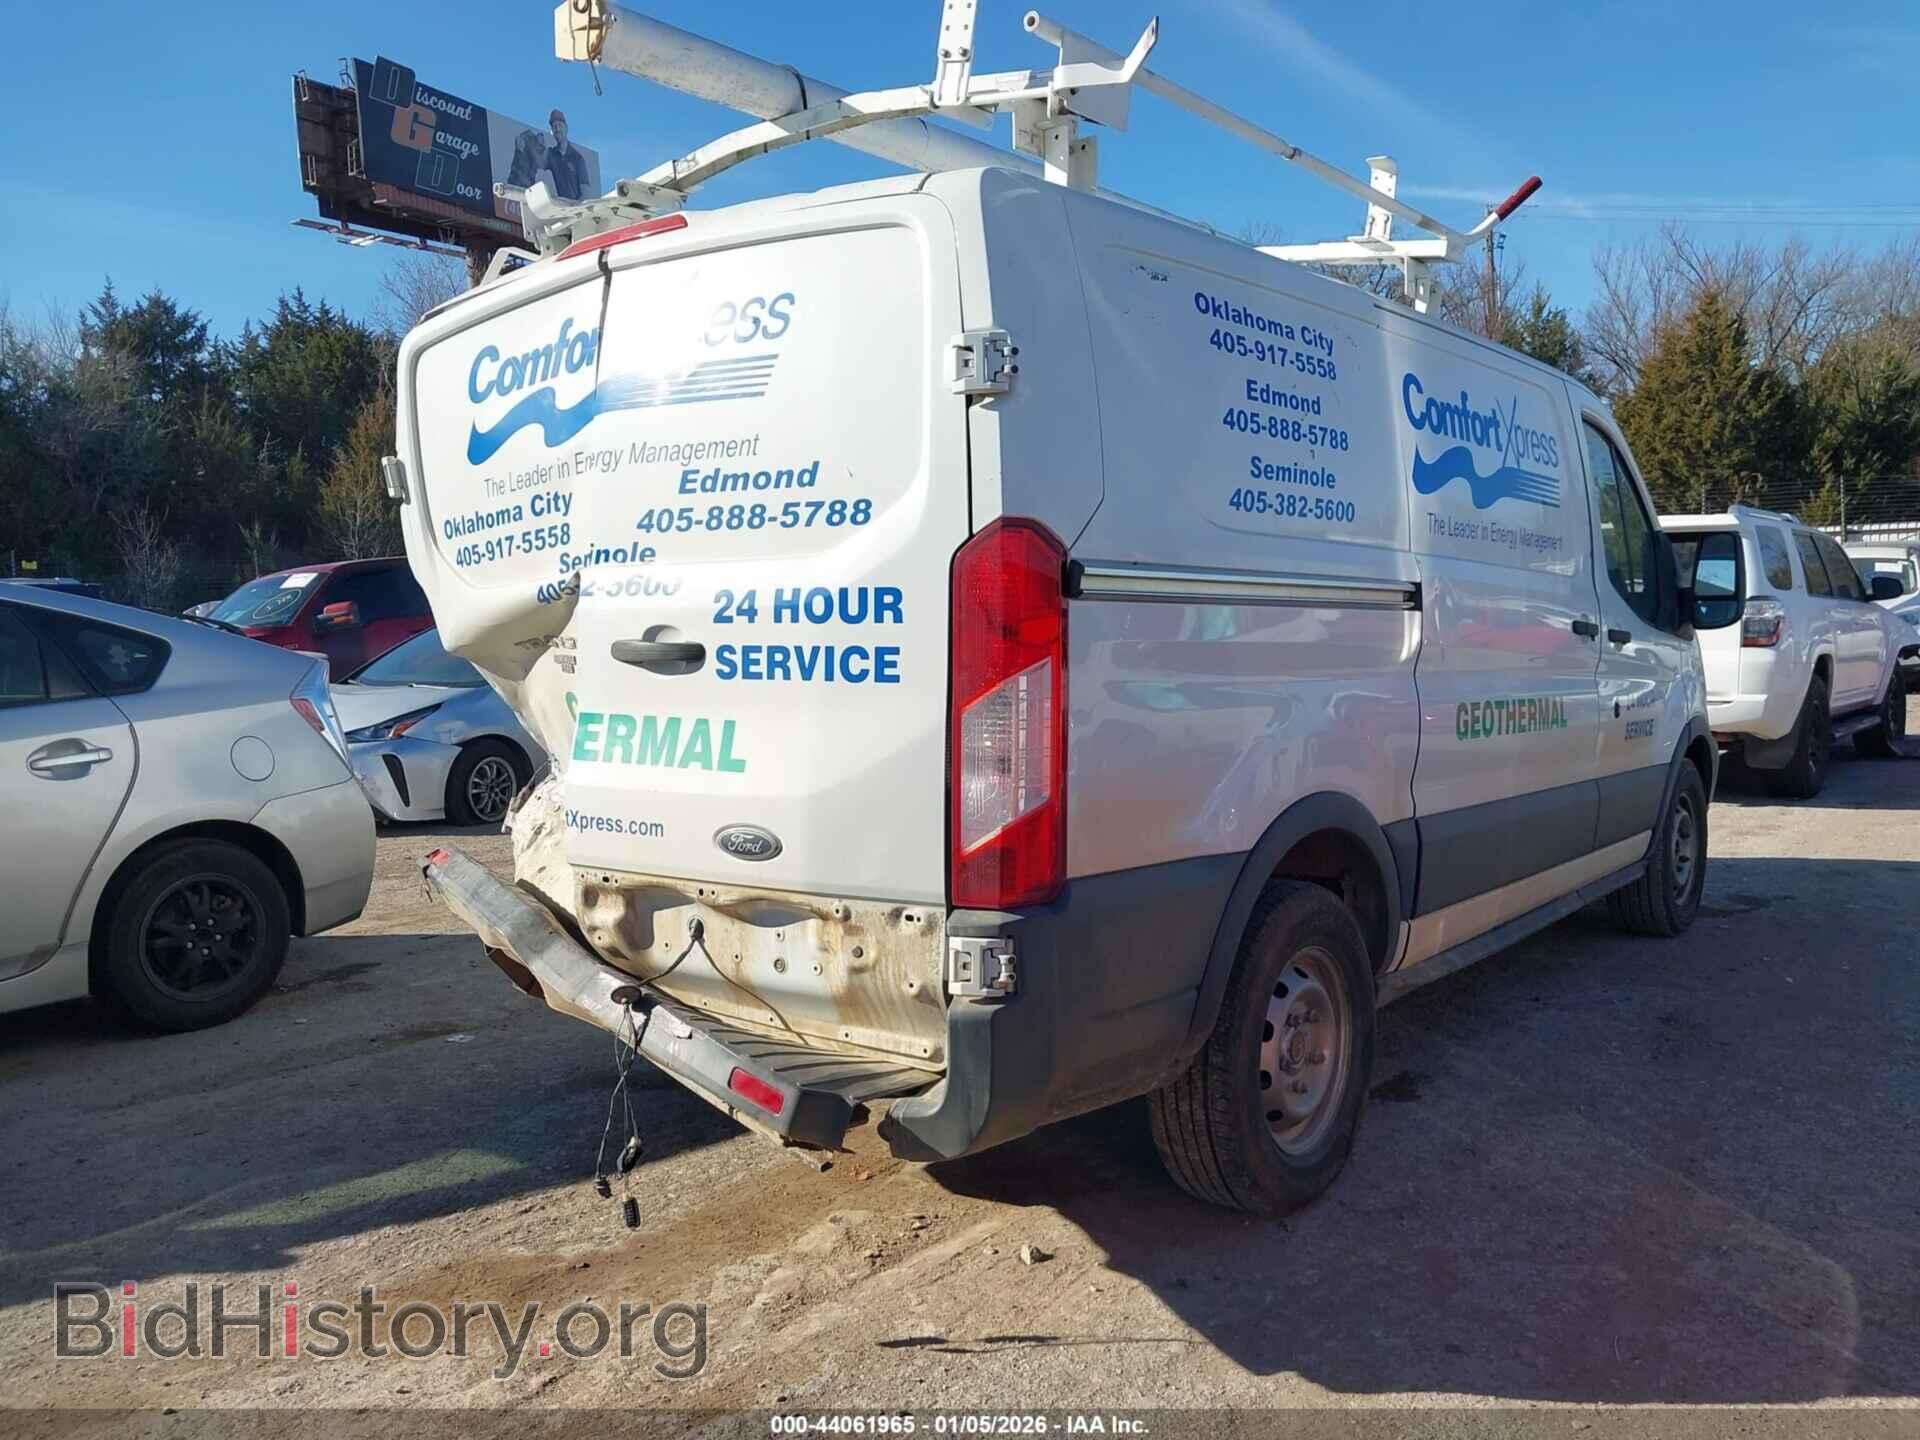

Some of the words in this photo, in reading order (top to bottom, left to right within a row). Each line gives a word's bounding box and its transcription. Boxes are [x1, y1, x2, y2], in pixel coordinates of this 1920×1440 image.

[1194, 292, 1296, 341] Oklahoma
[1300, 325, 1334, 356] City
[1209, 328, 1337, 380] 405-917-5558
[1246, 379, 1322, 416] Edmond
[1222, 407, 1349, 451] 405-888-5788
[484, 477, 506, 499] The
[509, 465, 554, 493] Leader
[557, 459, 571, 481] in
[628, 432, 760, 466] Management
[678, 461, 820, 494] Edmond
[1250, 455, 1337, 489] Seminole
[443, 504, 524, 541] Oklahoma
[530, 490, 573, 517] City
[636, 499, 873, 533] 405-888-5788
[1228, 487, 1355, 523] 405-382-5600
[1426, 512, 1446, 537] The
[1448, 516, 1480, 540] Leader
[455, 522, 571, 570] 405-917-5558
[713, 588, 758, 624] 24
[773, 586, 905, 625] HOUR
[716, 644, 901, 684] SERVICE
[1456, 698, 1568, 741] GEOTHERMAL
[727, 833, 763, 853] Ford
